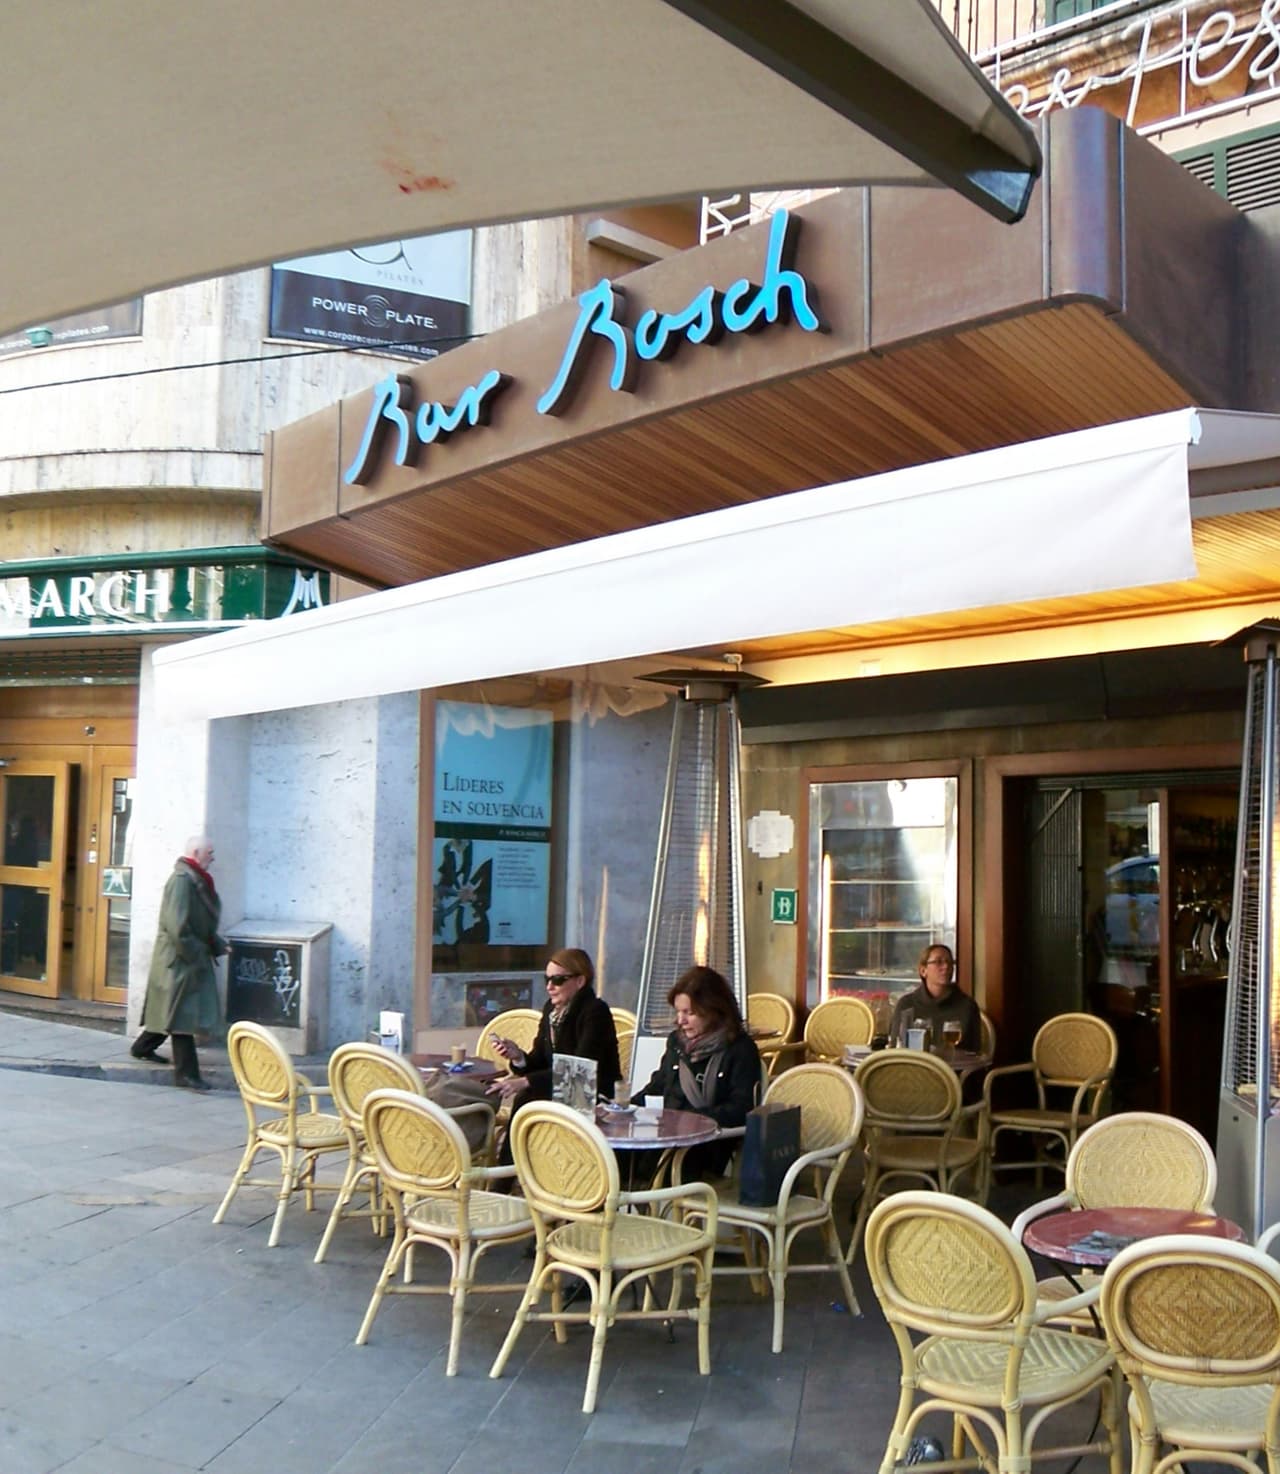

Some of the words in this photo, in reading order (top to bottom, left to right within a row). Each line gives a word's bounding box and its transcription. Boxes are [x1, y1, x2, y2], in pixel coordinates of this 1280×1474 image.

[312, 297, 368, 316] POWER
[345, 371, 501, 485] Bar
[0, 572, 169, 619] MARCH
[442, 800, 462, 815] EN
[467, 801, 545, 820] SOLVENCIA
